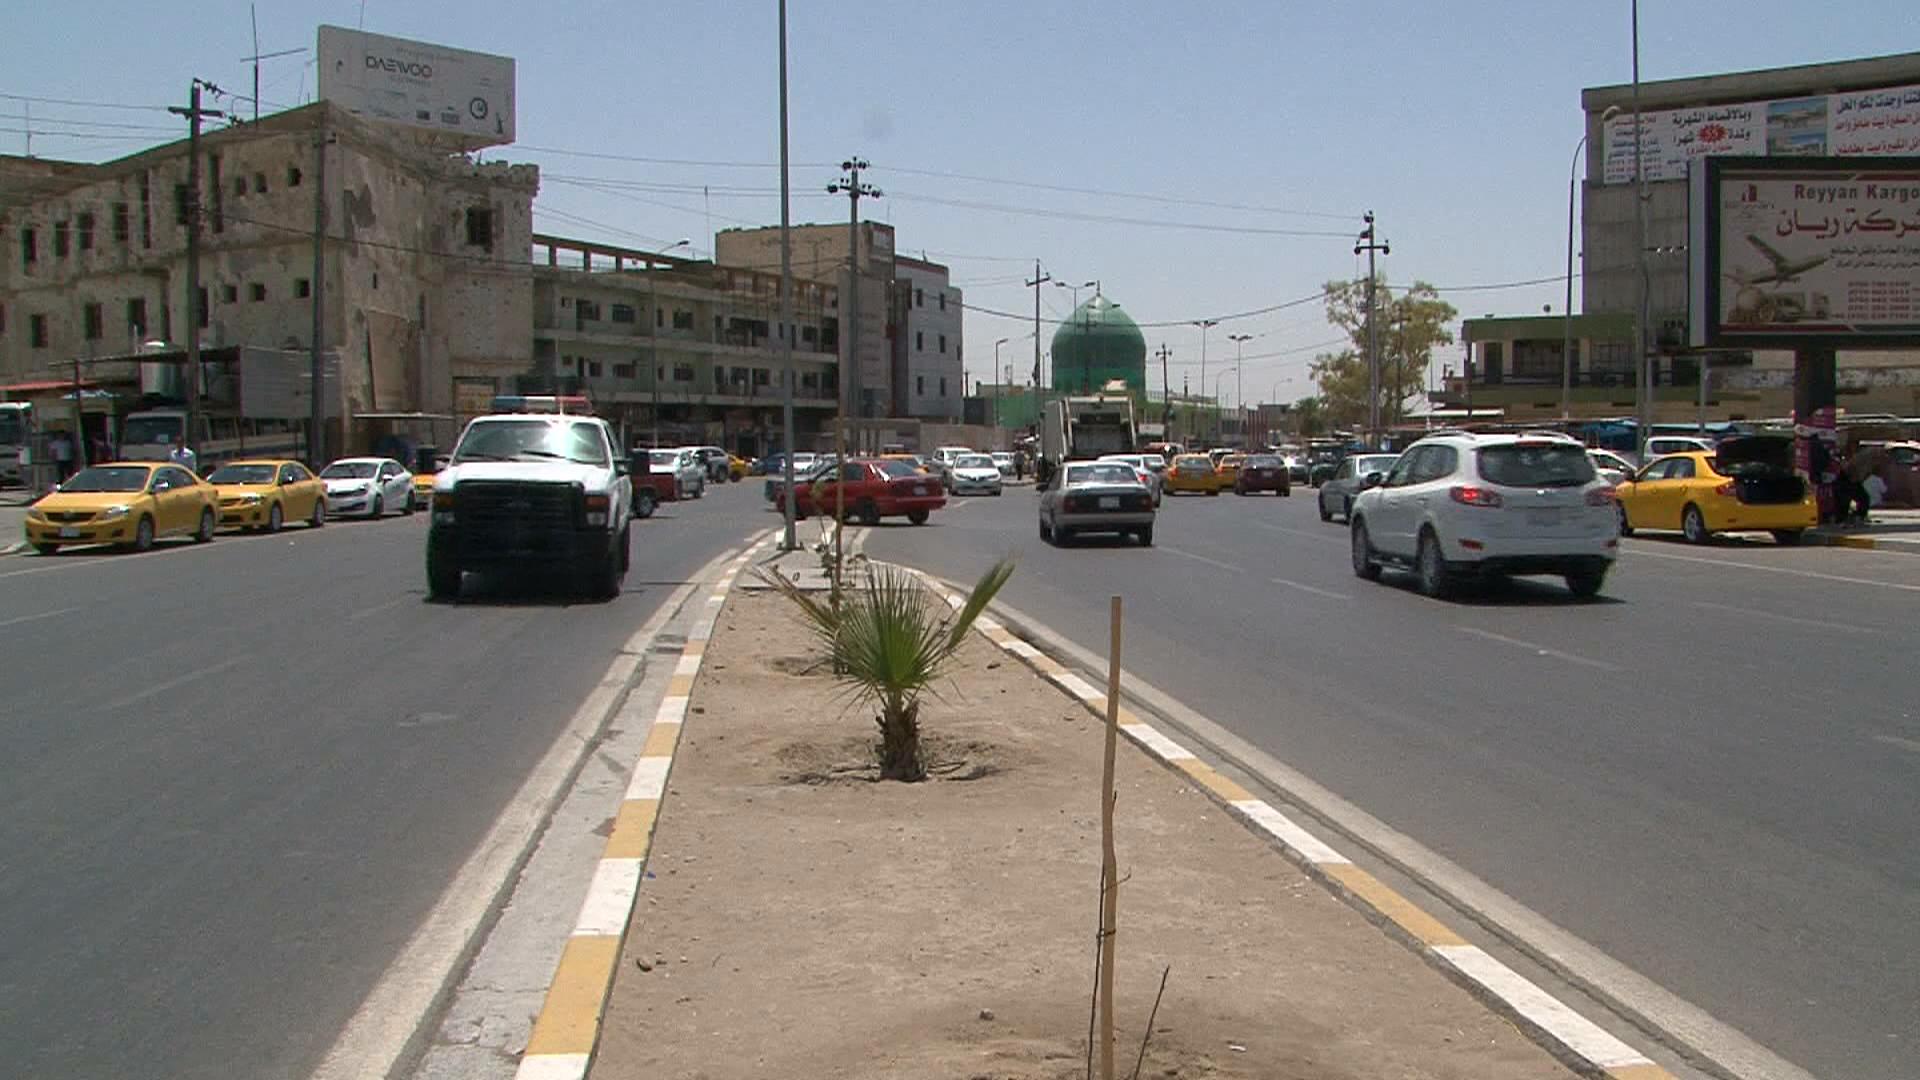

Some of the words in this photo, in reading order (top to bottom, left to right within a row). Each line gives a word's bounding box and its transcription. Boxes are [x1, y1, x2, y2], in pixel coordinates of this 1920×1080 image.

[365, 55, 433, 78] DAEWOO
[1794, 184, 1857, 202] Reyyan
[1866, 184, 1920, 202] Kargo
